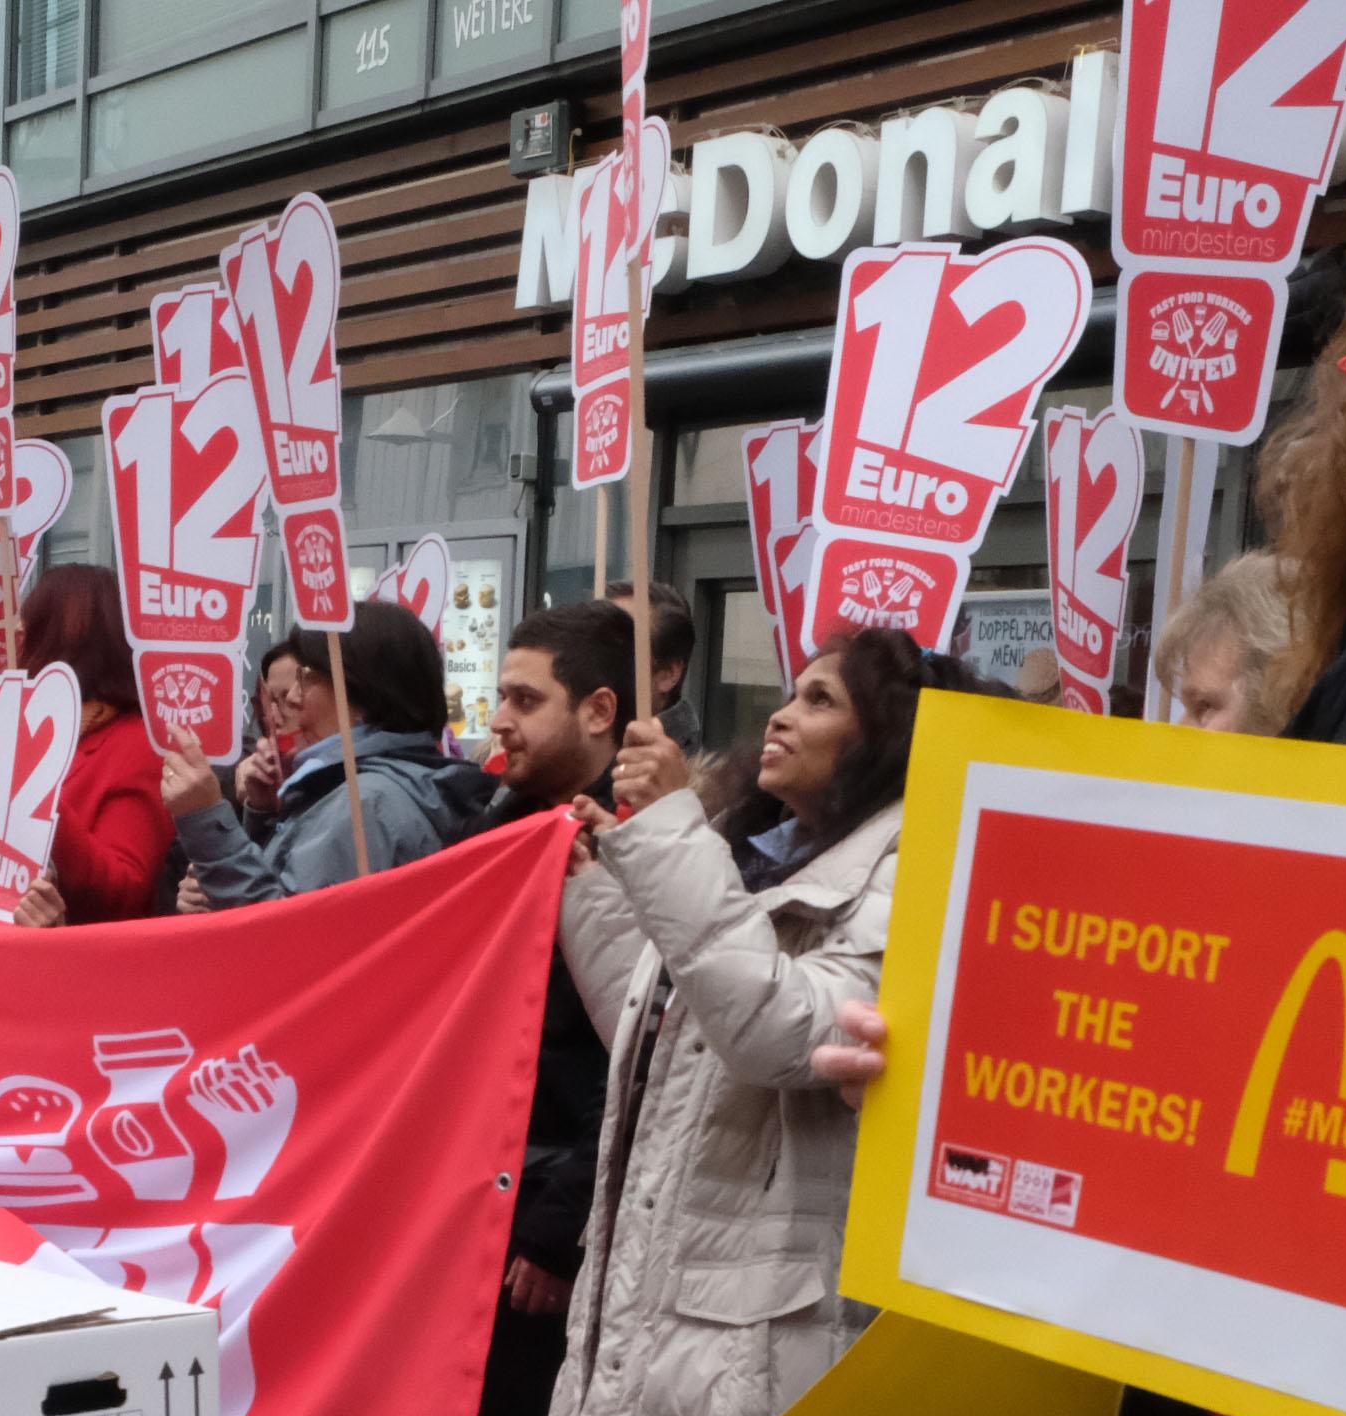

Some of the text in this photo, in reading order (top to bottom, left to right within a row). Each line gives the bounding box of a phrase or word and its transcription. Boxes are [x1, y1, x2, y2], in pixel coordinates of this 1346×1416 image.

[356, 24, 391, 74] 115
[1145, 152, 1281, 228] Euro
[1142, 223, 1276, 258] mindestens
[234, 202, 338, 434] 12
[1150, 291, 1253, 327] FAST FOOD WORKERS
[583, 321, 630, 364] Euro
[853, 244, 1083, 481] 12
[1149, 345, 1237, 382] UNITED
[273, 430, 328, 476] Euro
[114, 376, 266, 588] 12
[845, 446, 968, 516] Euro
[839, 503, 962, 539] mindestens
[1050, 413, 1139, 630] 12
[869, 558, 894, 569] FOOD
[139, 570, 228, 620] Euro
[838, 597, 920, 630] UNITED
[1058, 585, 1104, 655] Euro
[447, 659, 477, 673] Basics
[156, 704, 214, 725] UNITED
[985, 898, 1231, 985] I SUPPORT
[1053, 989, 1140, 1053] THE
[963, 1051, 1204, 1147] WORKERS!
